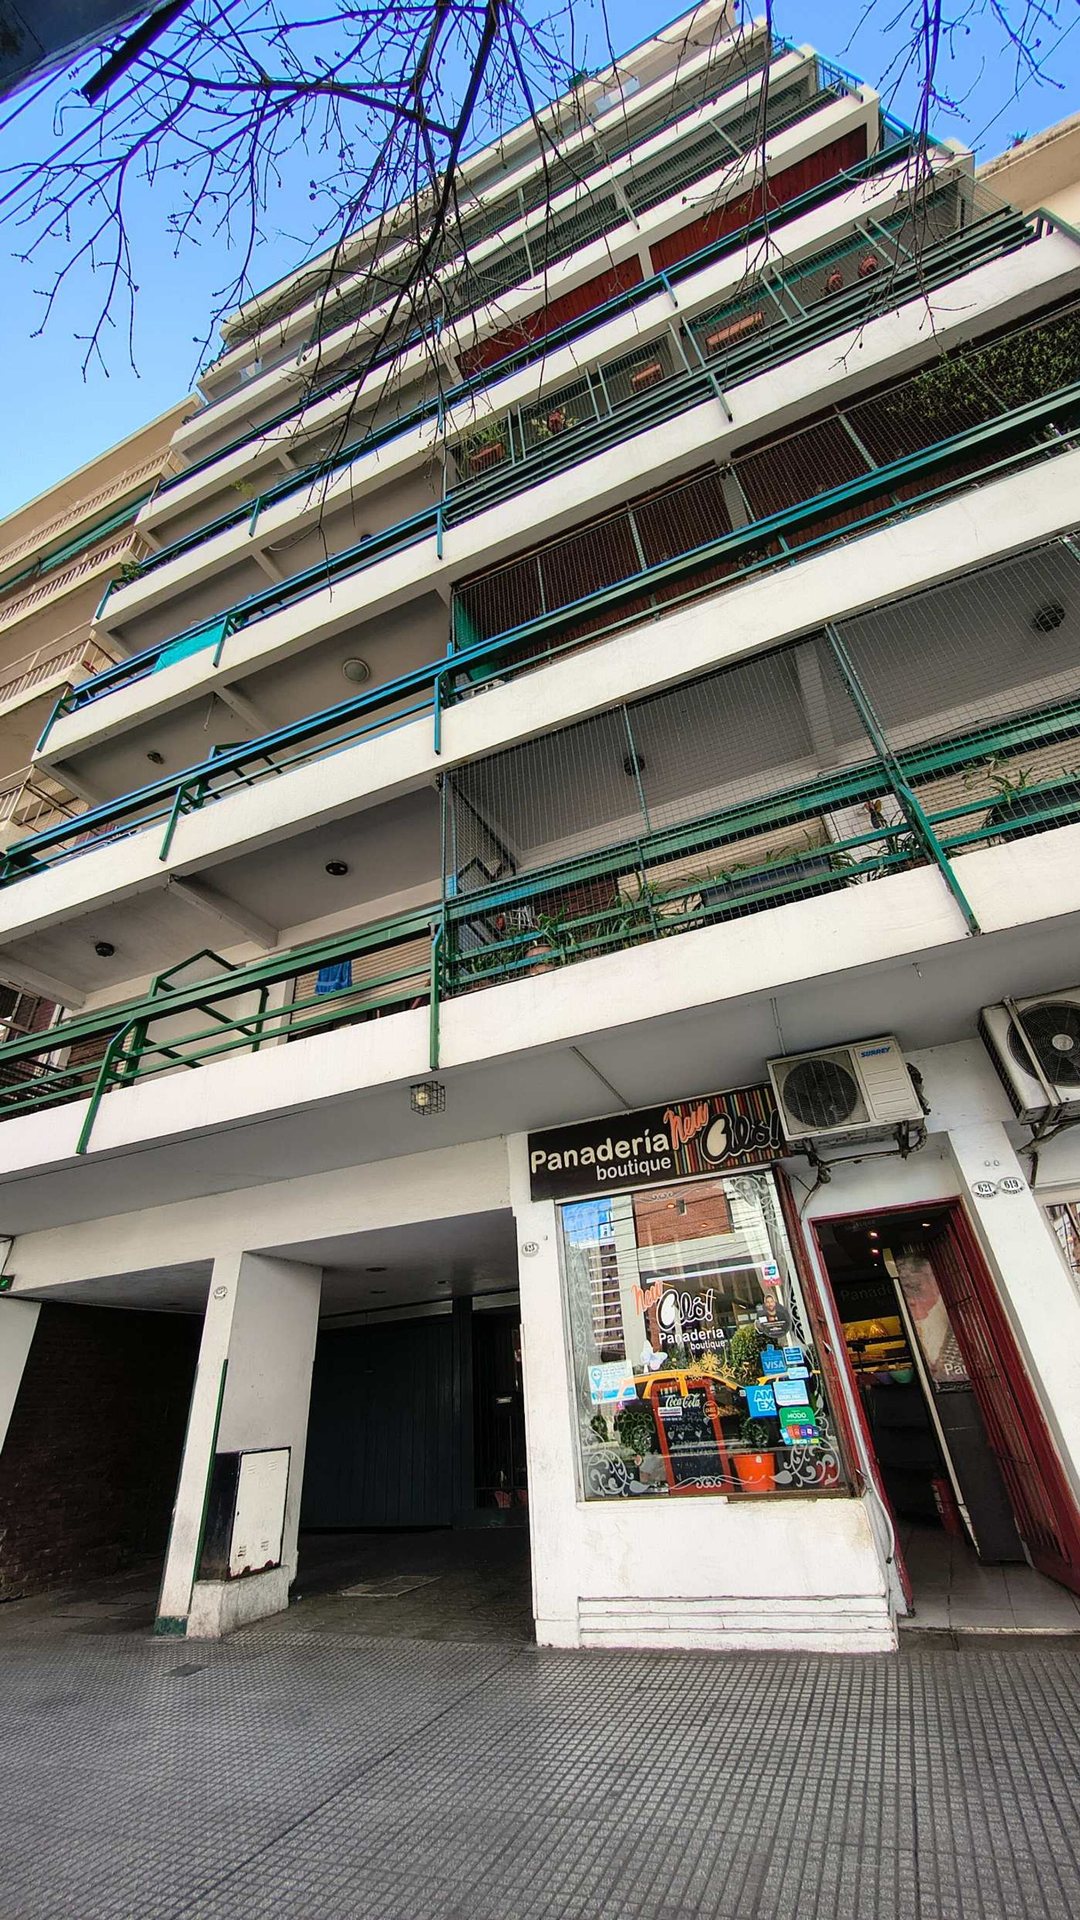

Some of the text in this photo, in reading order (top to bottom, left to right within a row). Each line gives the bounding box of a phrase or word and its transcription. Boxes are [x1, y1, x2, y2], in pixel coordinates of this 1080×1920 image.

[663, 1102, 709, 1150] New
[530, 1128, 670, 1174] Panadería
[596, 1156, 672, 1181] boutique
[977, 1183, 992, 1193] 621
[658, 1326, 725, 1346] Panadería
[690, 1340, 725, 1351] boutique
[764, 1361, 785, 1370] VISA
[754, 1390, 773, 1402] AM
[759, 1400, 776, 1412] EX
